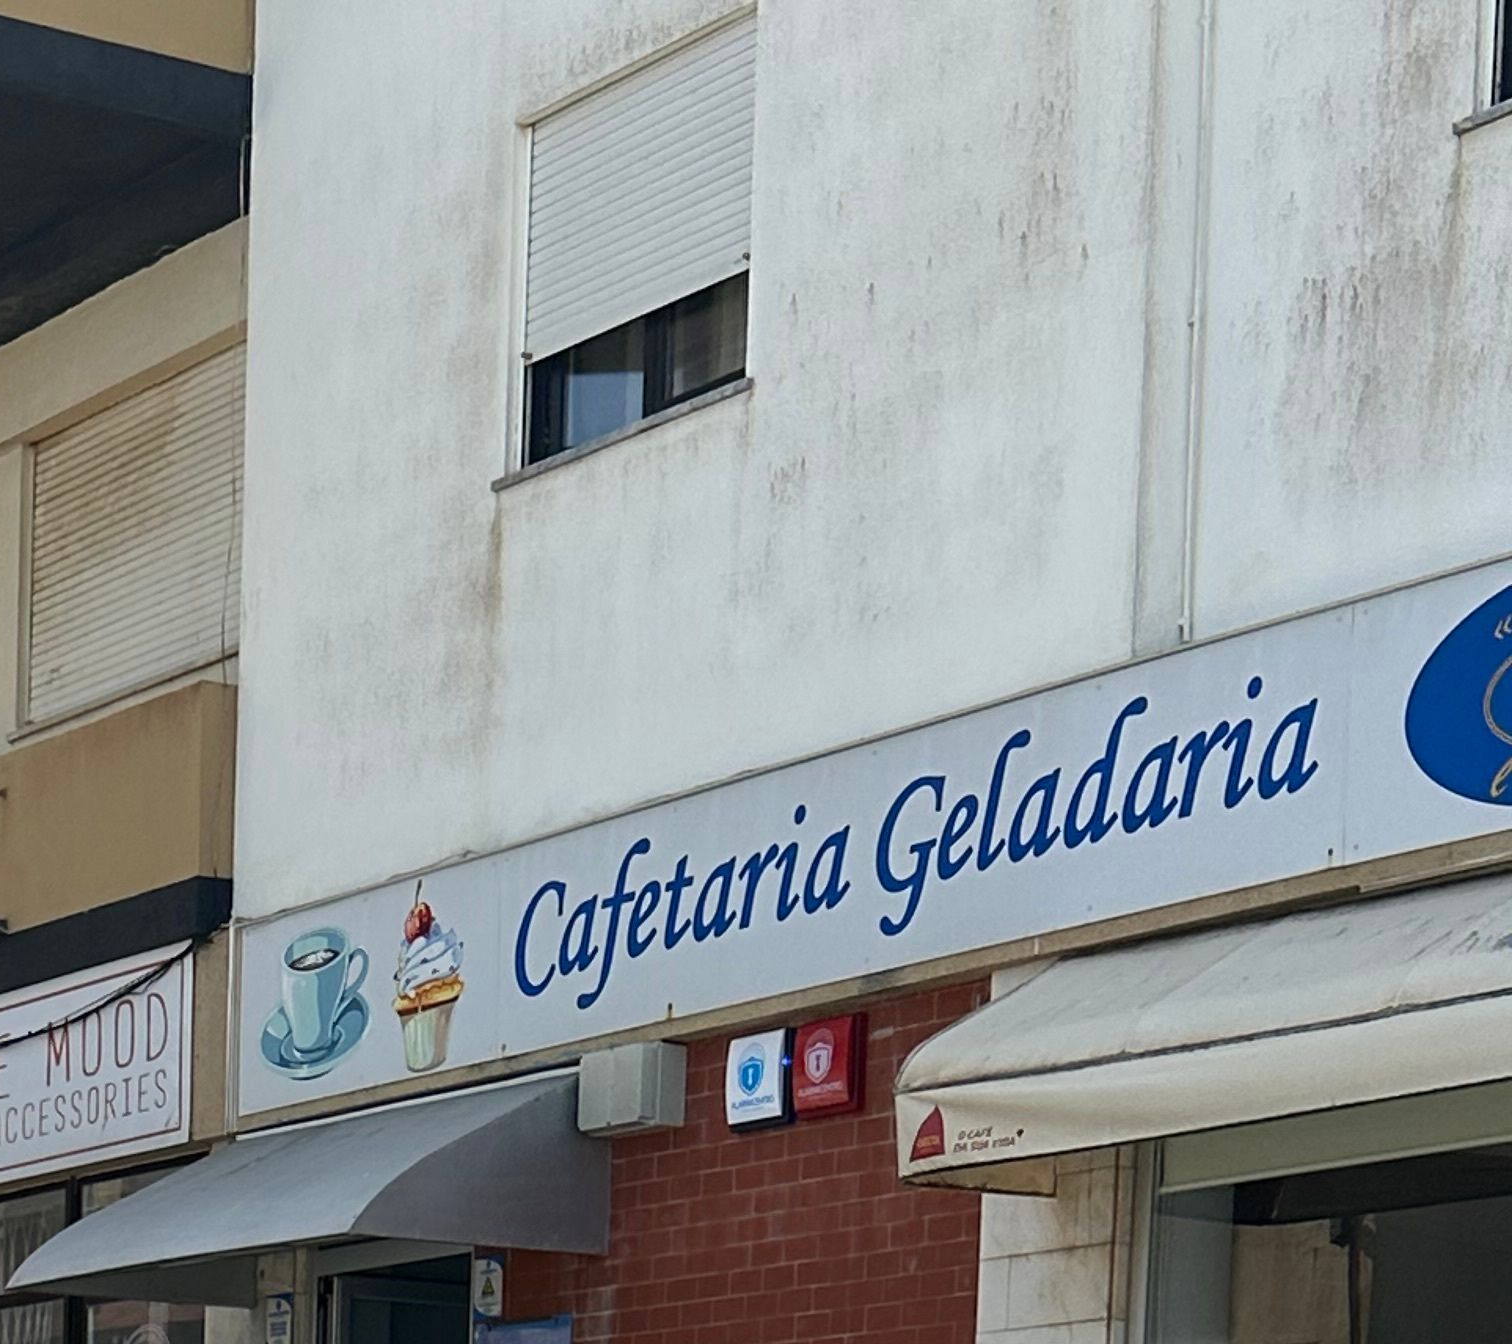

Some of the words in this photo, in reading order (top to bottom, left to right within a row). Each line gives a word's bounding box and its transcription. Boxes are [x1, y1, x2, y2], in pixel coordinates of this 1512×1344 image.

[513, 804, 851, 1010] Cafetaria
[874, 676, 1320, 937] Geladaria
[46, 992, 168, 1088] MOOD
